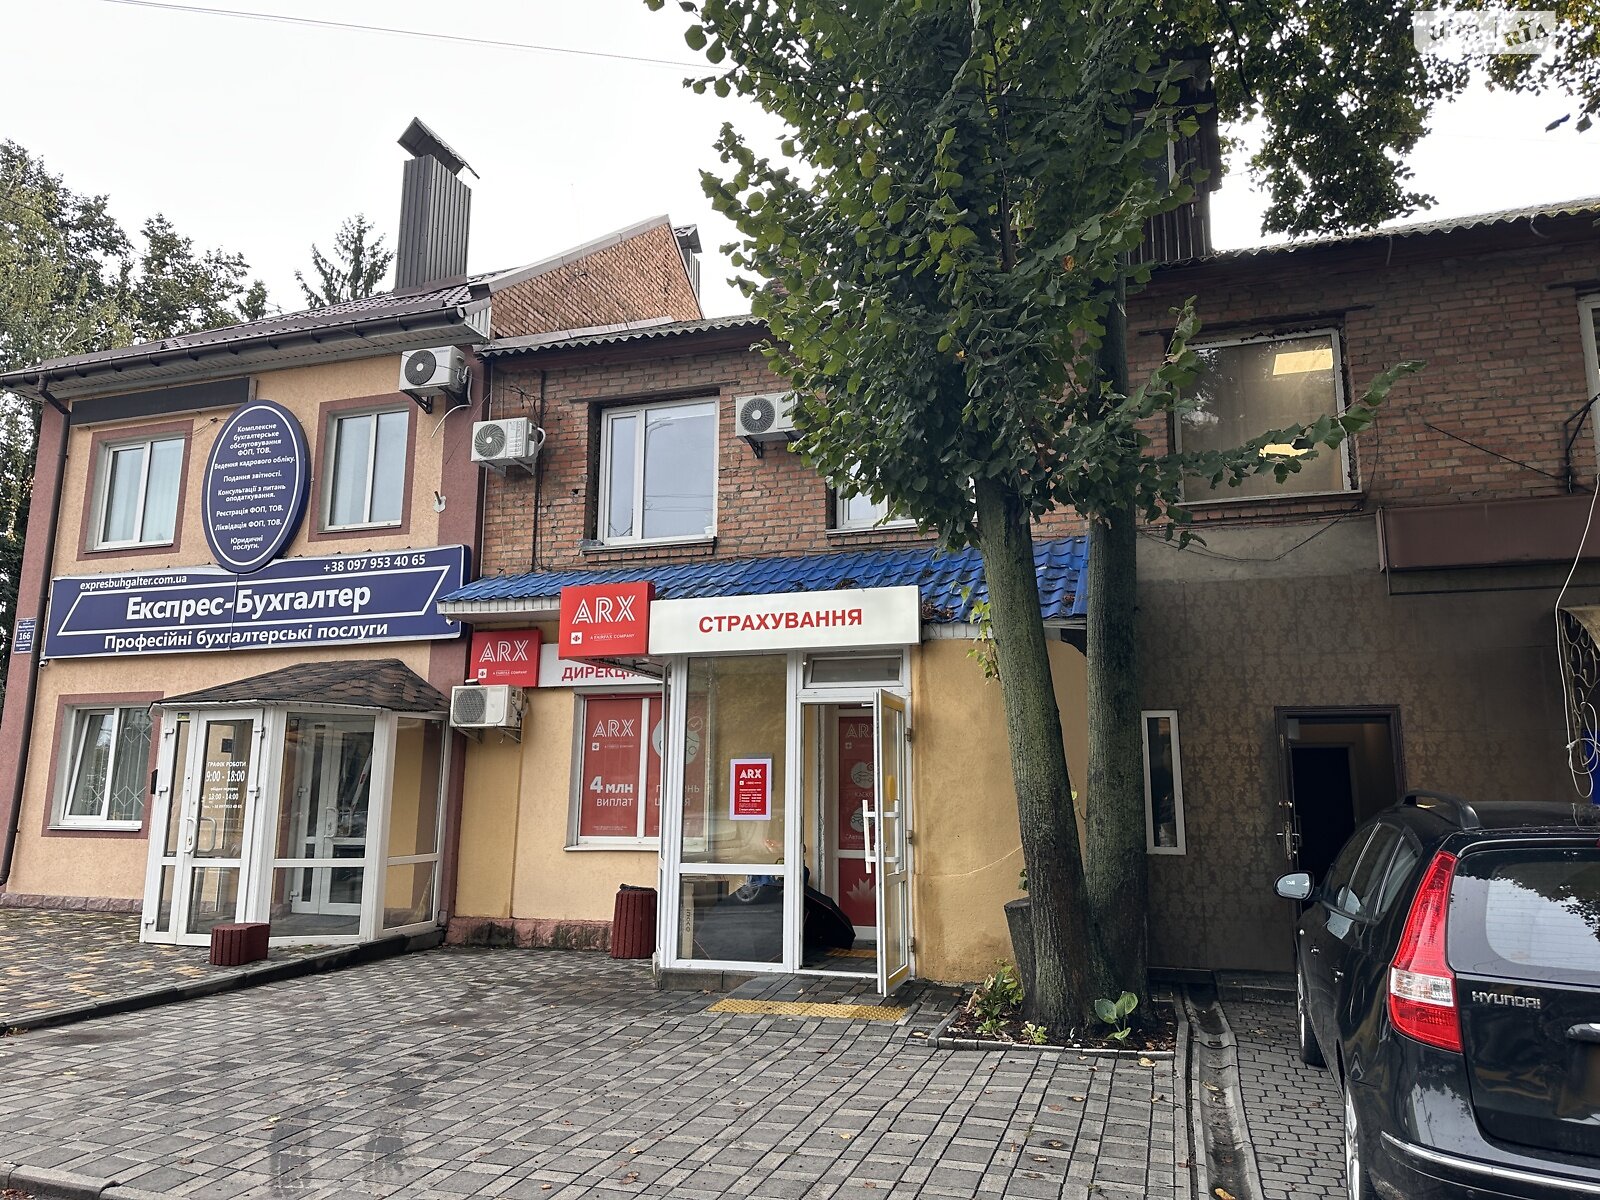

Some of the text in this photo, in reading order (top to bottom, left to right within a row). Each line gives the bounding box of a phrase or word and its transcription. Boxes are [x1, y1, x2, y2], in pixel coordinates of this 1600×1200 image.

[237, 423, 277, 432] Комплексне
[234, 431, 279, 442] бухгалтерське
[230, 440, 281, 449] обслуговування
[214, 456, 296, 470] Ведення кадрового обліку.
[223, 470, 282, 482] Подання звітності.
[218, 486, 257, 496] Консультації
[226, 493, 275, 502] оподаткування.
[216, 508, 248, 517] Реєстрація
[215, 522, 247, 531] Ліквідація
[231, 535, 263, 545] Юридичні
[324, 554, 426, 572] +38 097 953 40 65
[80, 575, 187, 591] expresbuhgalter.com.ua
[126, 586, 371, 624] Експрес-Бухгалтер
[572, 595, 635, 624] ARX
[698, 608, 863, 633] СТРАХУВАННЯ
[19, 632, 30, 640] 166
[104, 623, 388, 652] Професійні бухгалтерські послуги
[479, 640, 528, 662] ARX
[593, 718, 635, 738] ARX
[206, 771, 220, 782] 9:00
[227, 770, 245, 782] 18:00
[740, 769, 762, 778] ARX
[590, 776, 633, 794] 4 млн
[597, 798, 633, 807] виплат
[1472, 991, 1540, 1009] HYUNDAI
